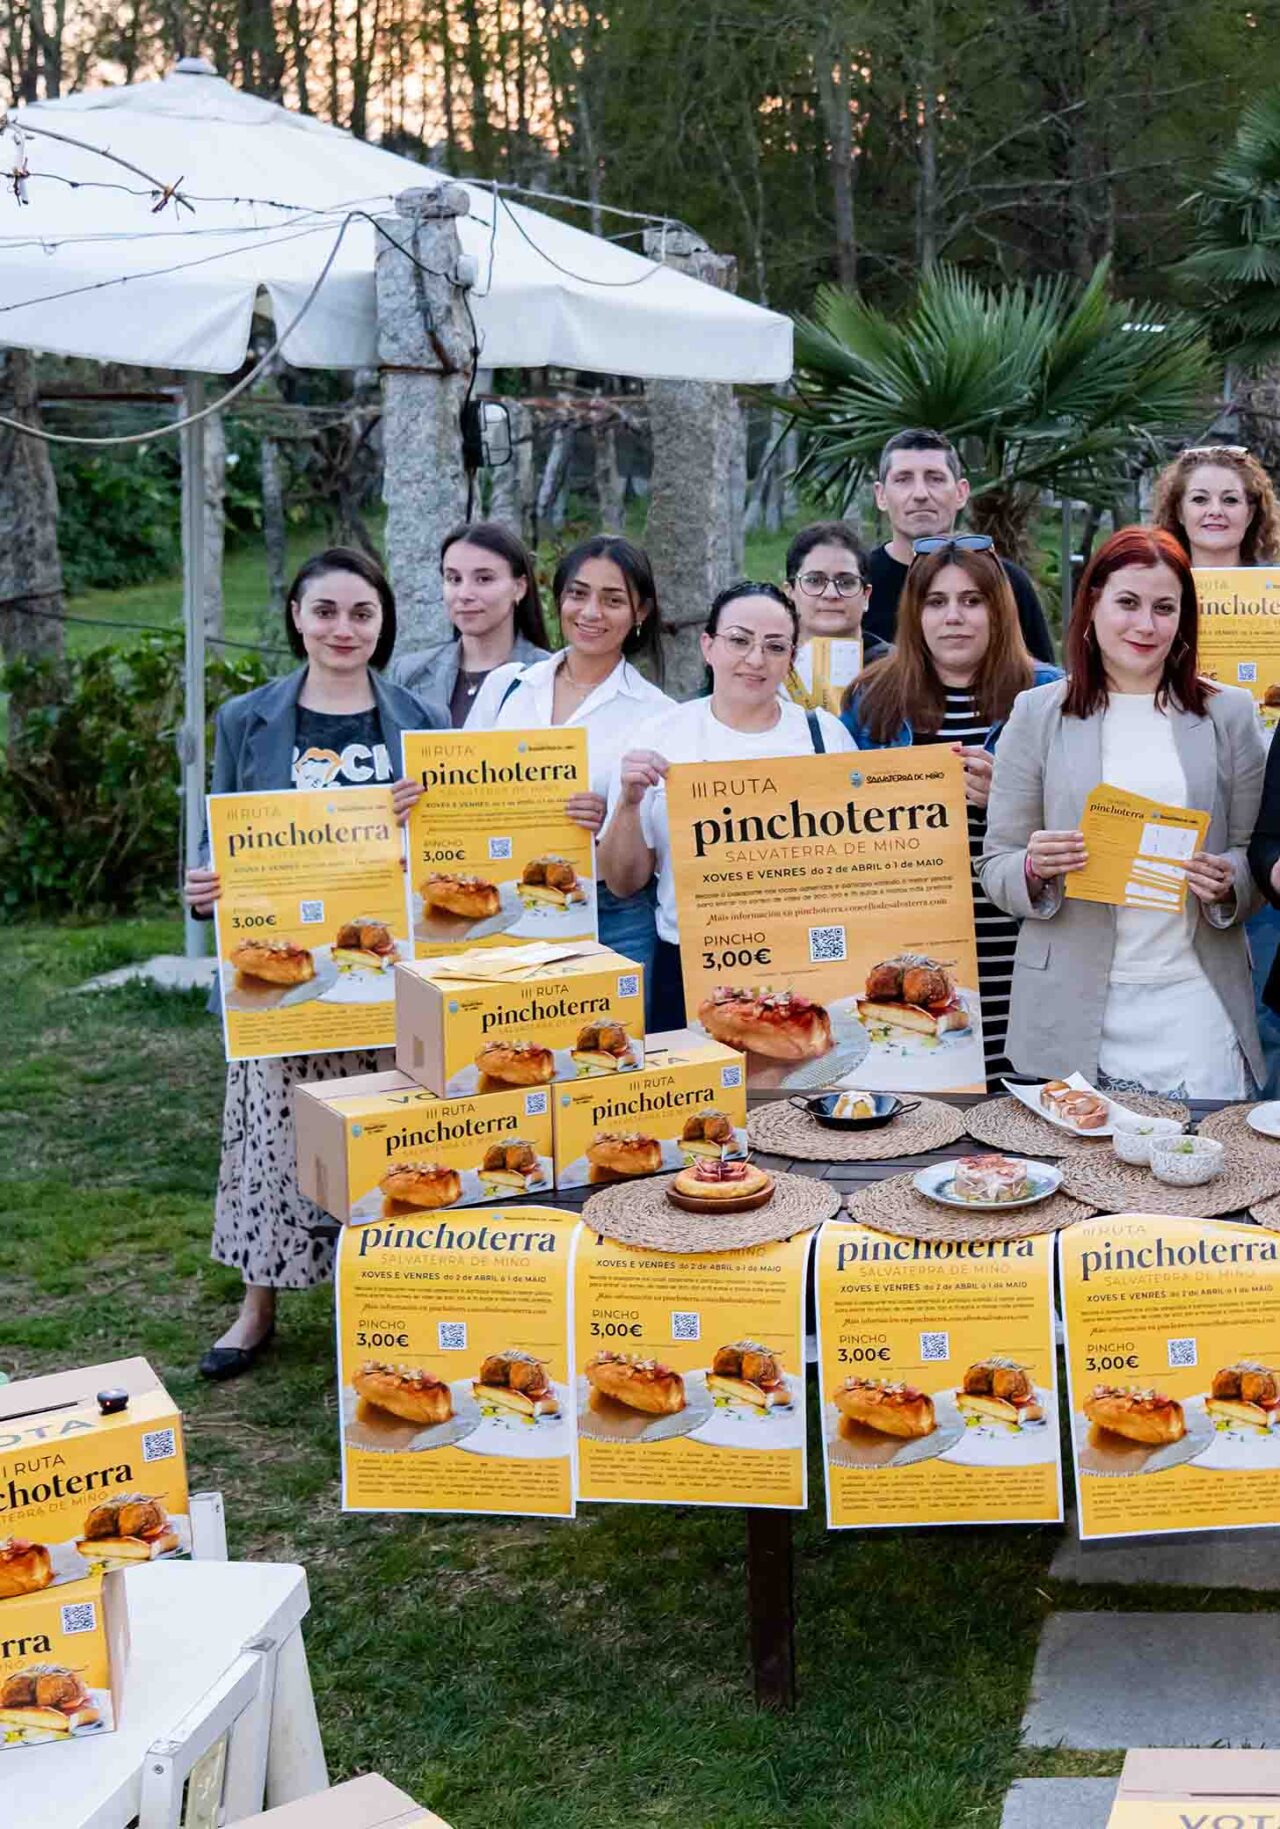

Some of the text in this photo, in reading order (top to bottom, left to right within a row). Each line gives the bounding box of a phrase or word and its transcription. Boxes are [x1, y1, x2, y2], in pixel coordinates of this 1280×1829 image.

[422, 760, 577, 792] pinchoterra
[714, 778, 777, 797] RUTA
[1090, 802, 1145, 819] pinchoterra
[692, 799, 949, 857] pinchoterra
[229, 822, 389, 857] pinchoterra
[423, 851, 465, 863] 3,00€
[725, 844, 837, 864] SALVATERRA
[844, 841, 866, 855] DE
[702, 871, 743, 883] XOVES
[748, 870, 753, 879] E
[758, 867, 806, 879] VENRES
[811, 866, 823, 875] do
[826, 866, 832, 874] 2
[836, 864, 848, 873] de
[852, 862, 881, 873] ABRIL
[900, 859, 913, 868] de
[916, 857, 944, 867] MAIO
[232, 915, 277, 929] 3,00€
[704, 932, 766, 946] PINCHO
[702, 948, 771, 971] 3,00€
[521, 984, 569, 999] III RUTA
[482, 997, 611, 1033] pinchoterra
[644, 1077, 675, 1088] RUTA
[442, 1103, 476, 1117] RUTA
[593, 1087, 715, 1125] pinchoterra
[386, 1115, 518, 1156] pinchoterra
[359, 1223, 555, 1256] pinchoterra
[837, 1236, 1034, 1271] pinchoterra
[1081, 1238, 1278, 1281] pinchoterra
[597, 1260, 627, 1268] XOVES
[639, 1261, 675, 1269] VENRES
[760, 1265, 782, 1273] MAIO
[361, 1271, 392, 1279] XOVES
[404, 1272, 440, 1280] VENRES
[840, 1284, 872, 1293] XOVES
[883, 1283, 920, 1291] VENRES
[1087, 1293, 1117, 1302] XOVES
[1129, 1290, 1166, 1300] VENRES
[593, 1310, 639, 1320] PINCHO
[359, 1320, 406, 1330] PINCHO
[590, 1323, 643, 1339] 3,00€
[357, 1333, 409, 1348] 3,00€
[840, 1334, 887, 1344] PINCHO
[1087, 1342, 1135, 1353] PINCHO
[838, 1347, 891, 1364] 3,00€
[1086, 1355, 1139, 1373] 3,00€
[15, 1454, 66, 1476] RUTA
[0, 1463, 134, 1512] hoterra
